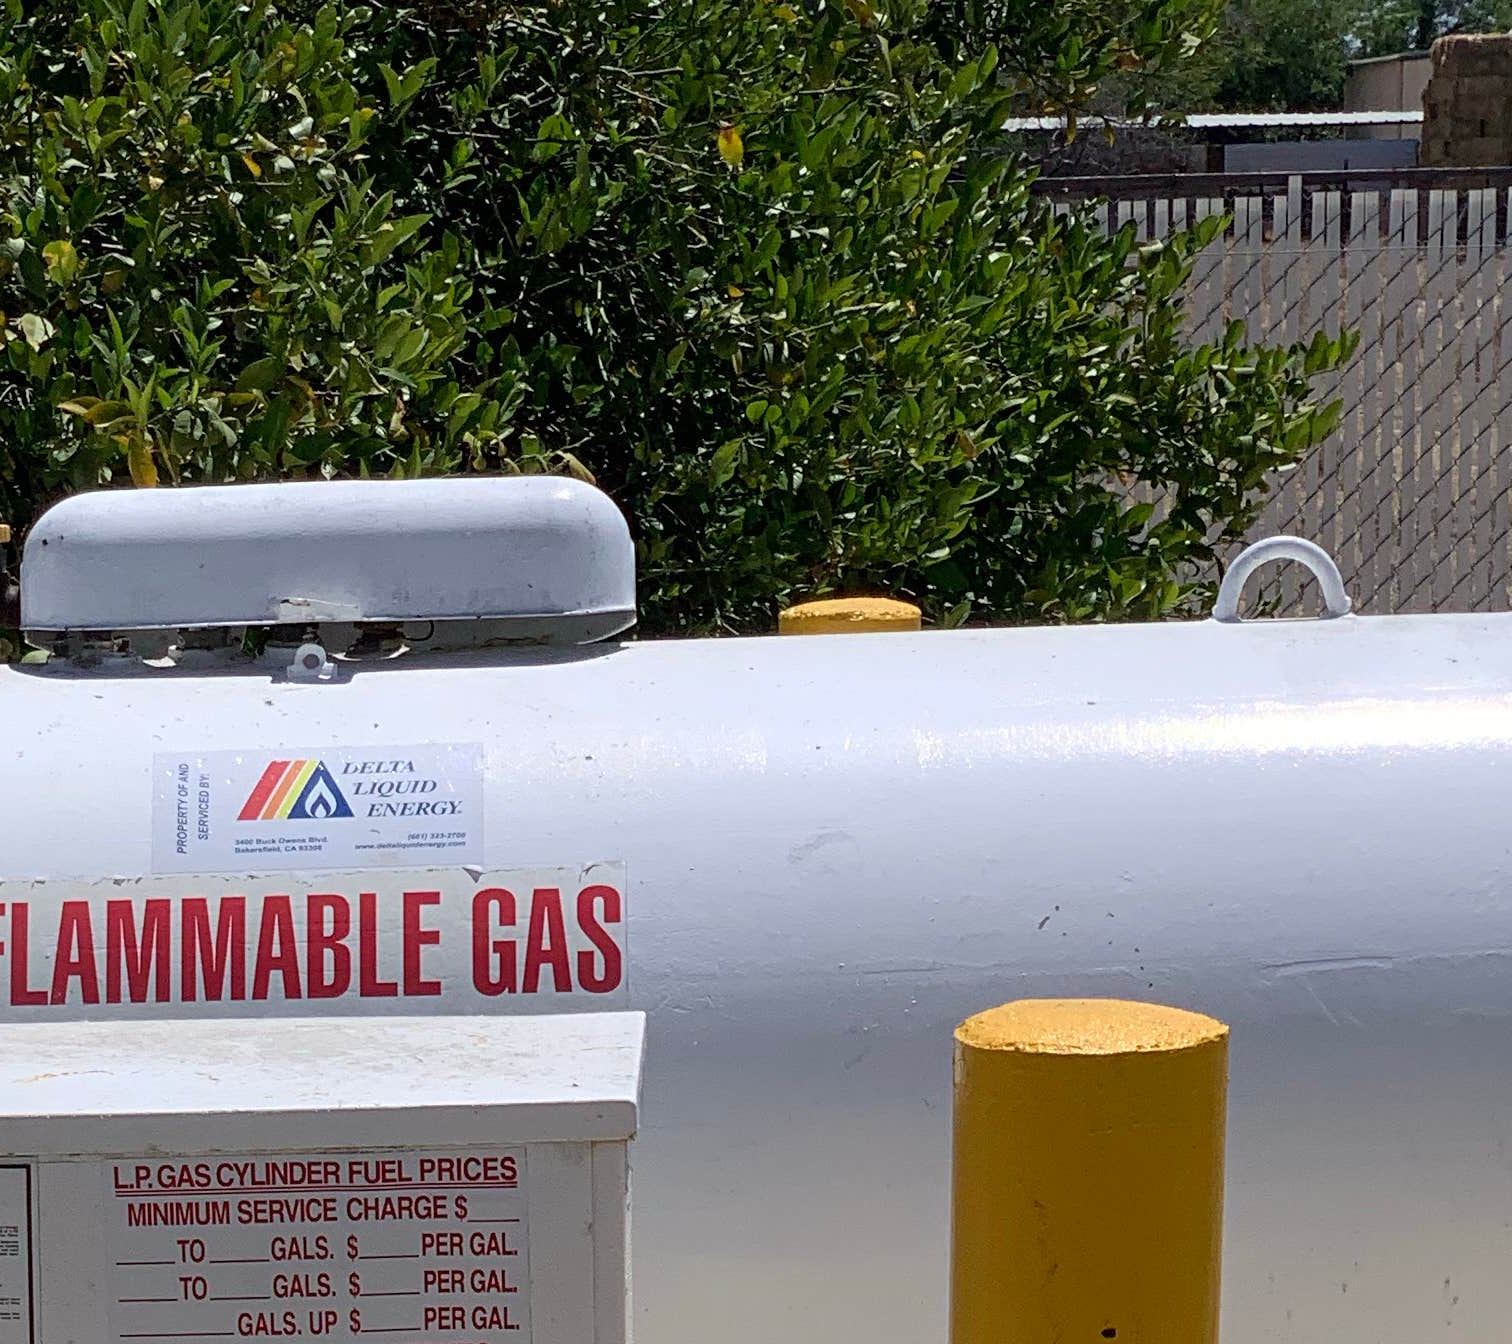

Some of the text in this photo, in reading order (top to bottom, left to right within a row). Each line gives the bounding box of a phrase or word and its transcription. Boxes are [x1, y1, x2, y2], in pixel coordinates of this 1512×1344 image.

[342, 760, 415, 774] DELTA
[353, 780, 437, 797] LIQUID
[176, 764, 189, 854] PROPERTY OF AND
[198, 790, 209, 841] SERVICED
[367, 800, 461, 817] ENERGY
[471, 884, 621, 997] GAS
[113, 1156, 518, 1190] L.P. GAS CYLINDER FUEL PRICES
[127, 1200, 230, 1227] MINIMUM
[237, 1197, 338, 1224] SERVICE
[346, 1195, 448, 1221] CHARGE
[176, 1238, 205, 1263] TO
[271, 1235, 334, 1261] GALS.
[421, 1232, 463, 1256] PER
[469, 1231, 518, 1256] GAL.
[178, 1276, 207, 1300] TO
[273, 1272, 336, 1298] GALS.
[423, 1269, 465, 1293] PER
[470, 1268, 517, 1293] GAL.
[237, 1311, 302, 1336] GALS.
[309, 1310, 337, 1335] UP
[424, 1306, 465, 1330] PER
[471, 1305, 520, 1330] GAL.
